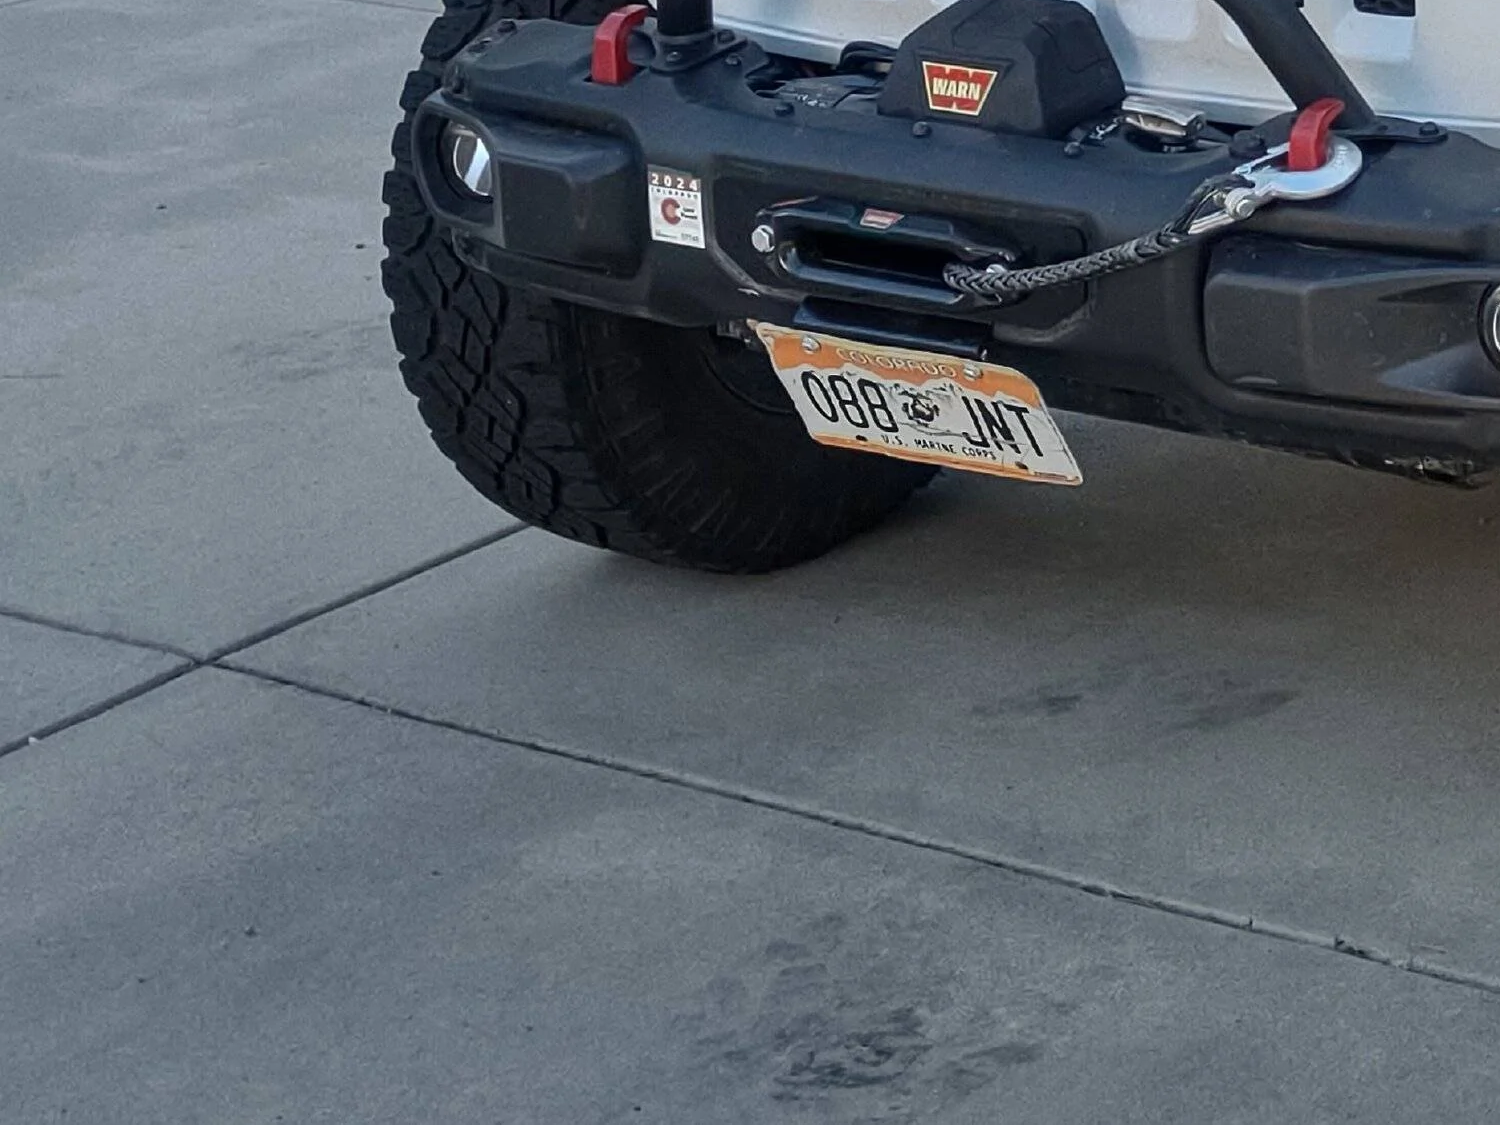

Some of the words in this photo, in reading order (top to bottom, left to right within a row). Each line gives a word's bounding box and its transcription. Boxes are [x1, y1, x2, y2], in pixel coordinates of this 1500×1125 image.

[932, 77, 981, 101] WARN
[650, 172, 699, 192] 2024
[836, 348, 957, 377] COLORADO
[800, 371, 900, 433] 088
[961, 396, 1043, 457] JNT
[881, 434, 908, 447] U.S.
[914, 438, 957, 454] MARINE
[961, 446, 997, 461] CORPS
